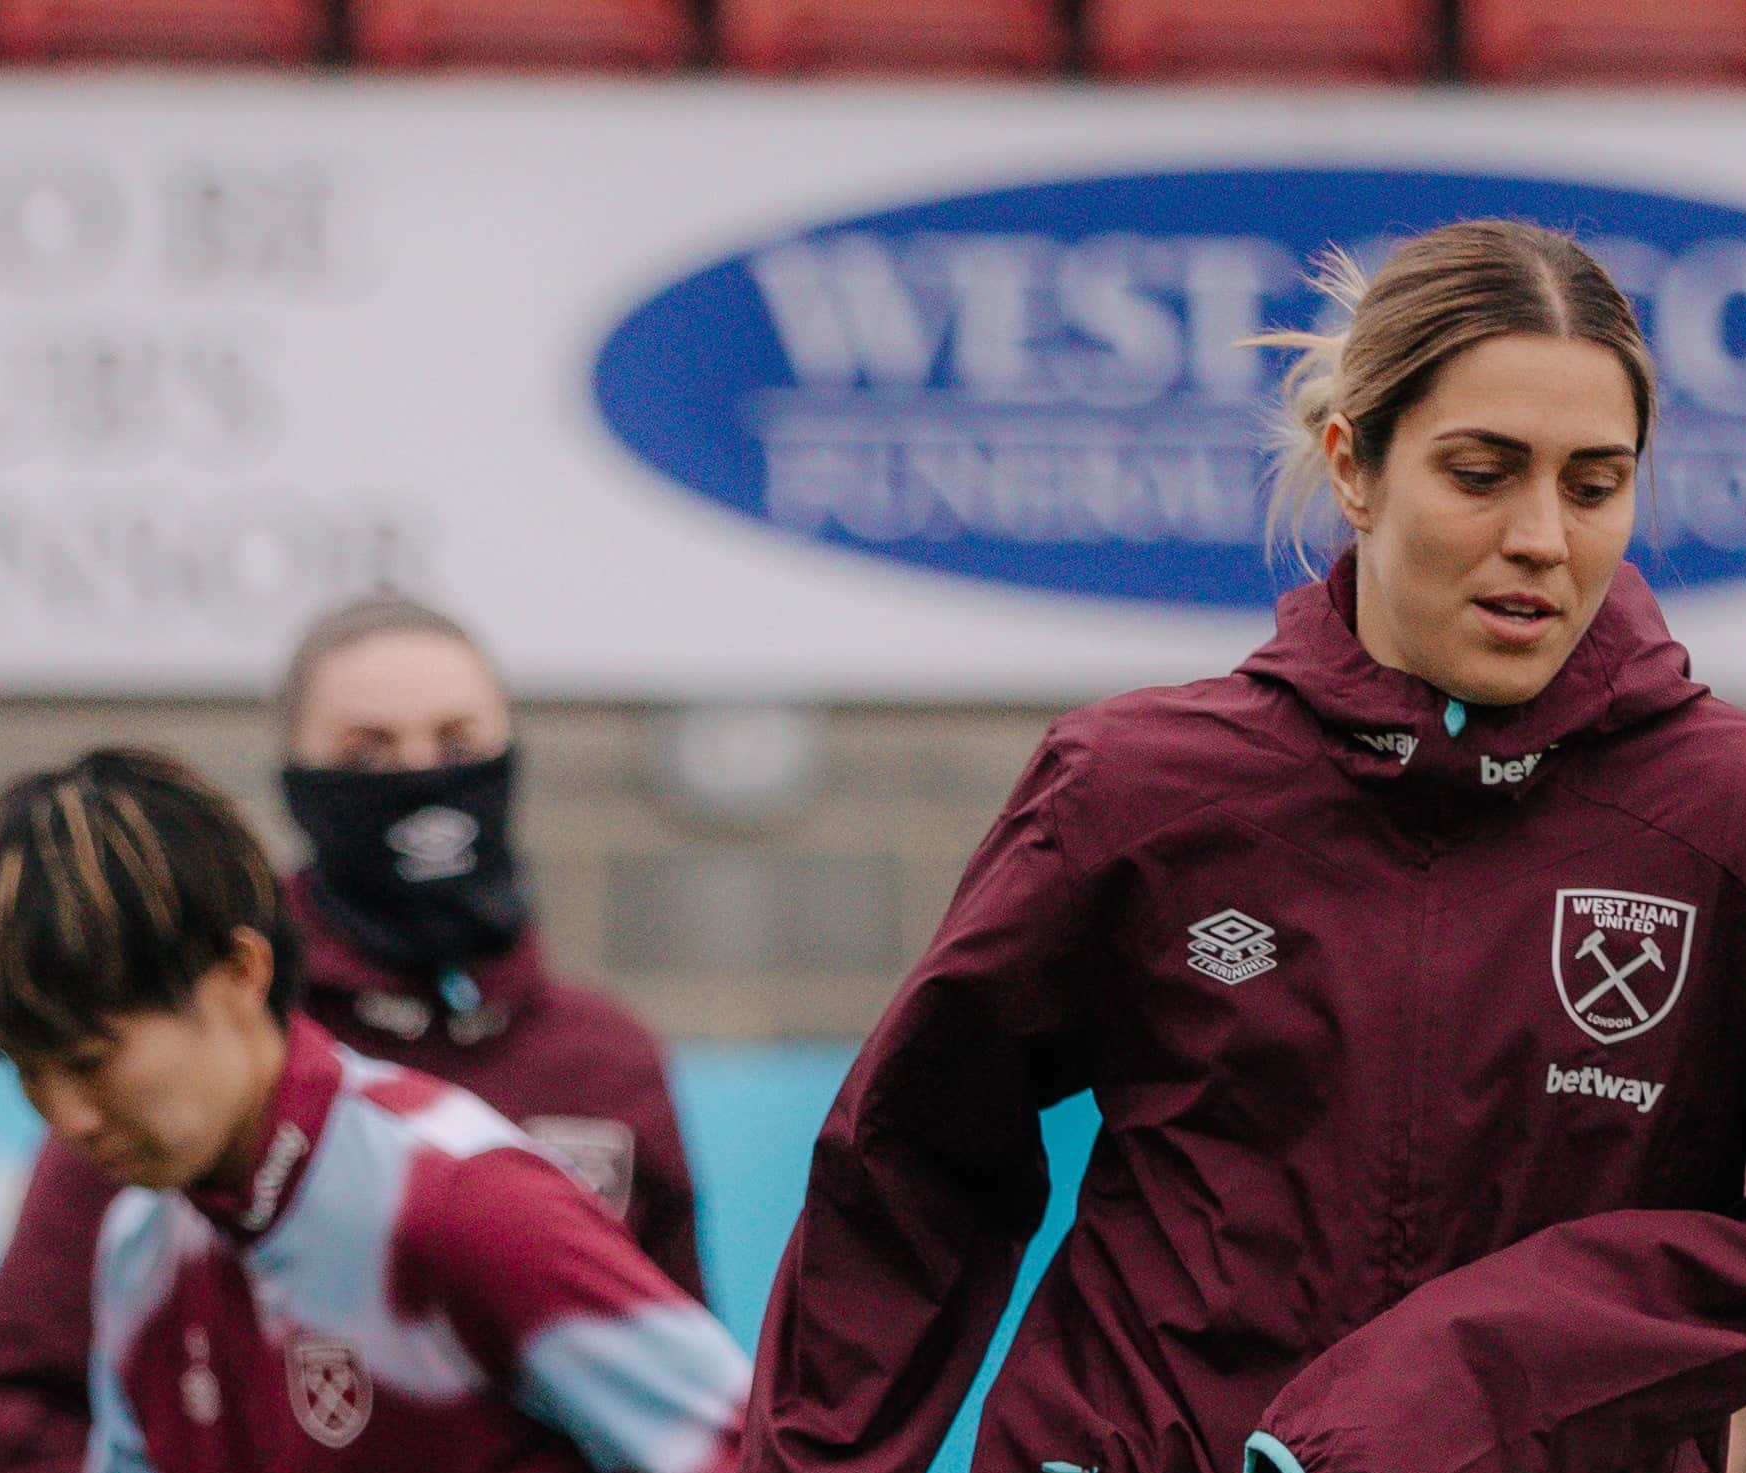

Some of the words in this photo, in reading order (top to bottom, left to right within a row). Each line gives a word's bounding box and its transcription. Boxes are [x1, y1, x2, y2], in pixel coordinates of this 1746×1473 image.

[159, 143, 364, 290] BE
[756, 238, 1294, 408] WEST
[1572, 897, 1628, 917] WEST
[1630, 899, 1679, 928] HAM
[1594, 914, 1656, 935] UNITED
[1197, 956, 1269, 980] TRAINING
[1587, 1011, 1633, 1029] LONDON
[1545, 1063, 1665, 1114] betway
